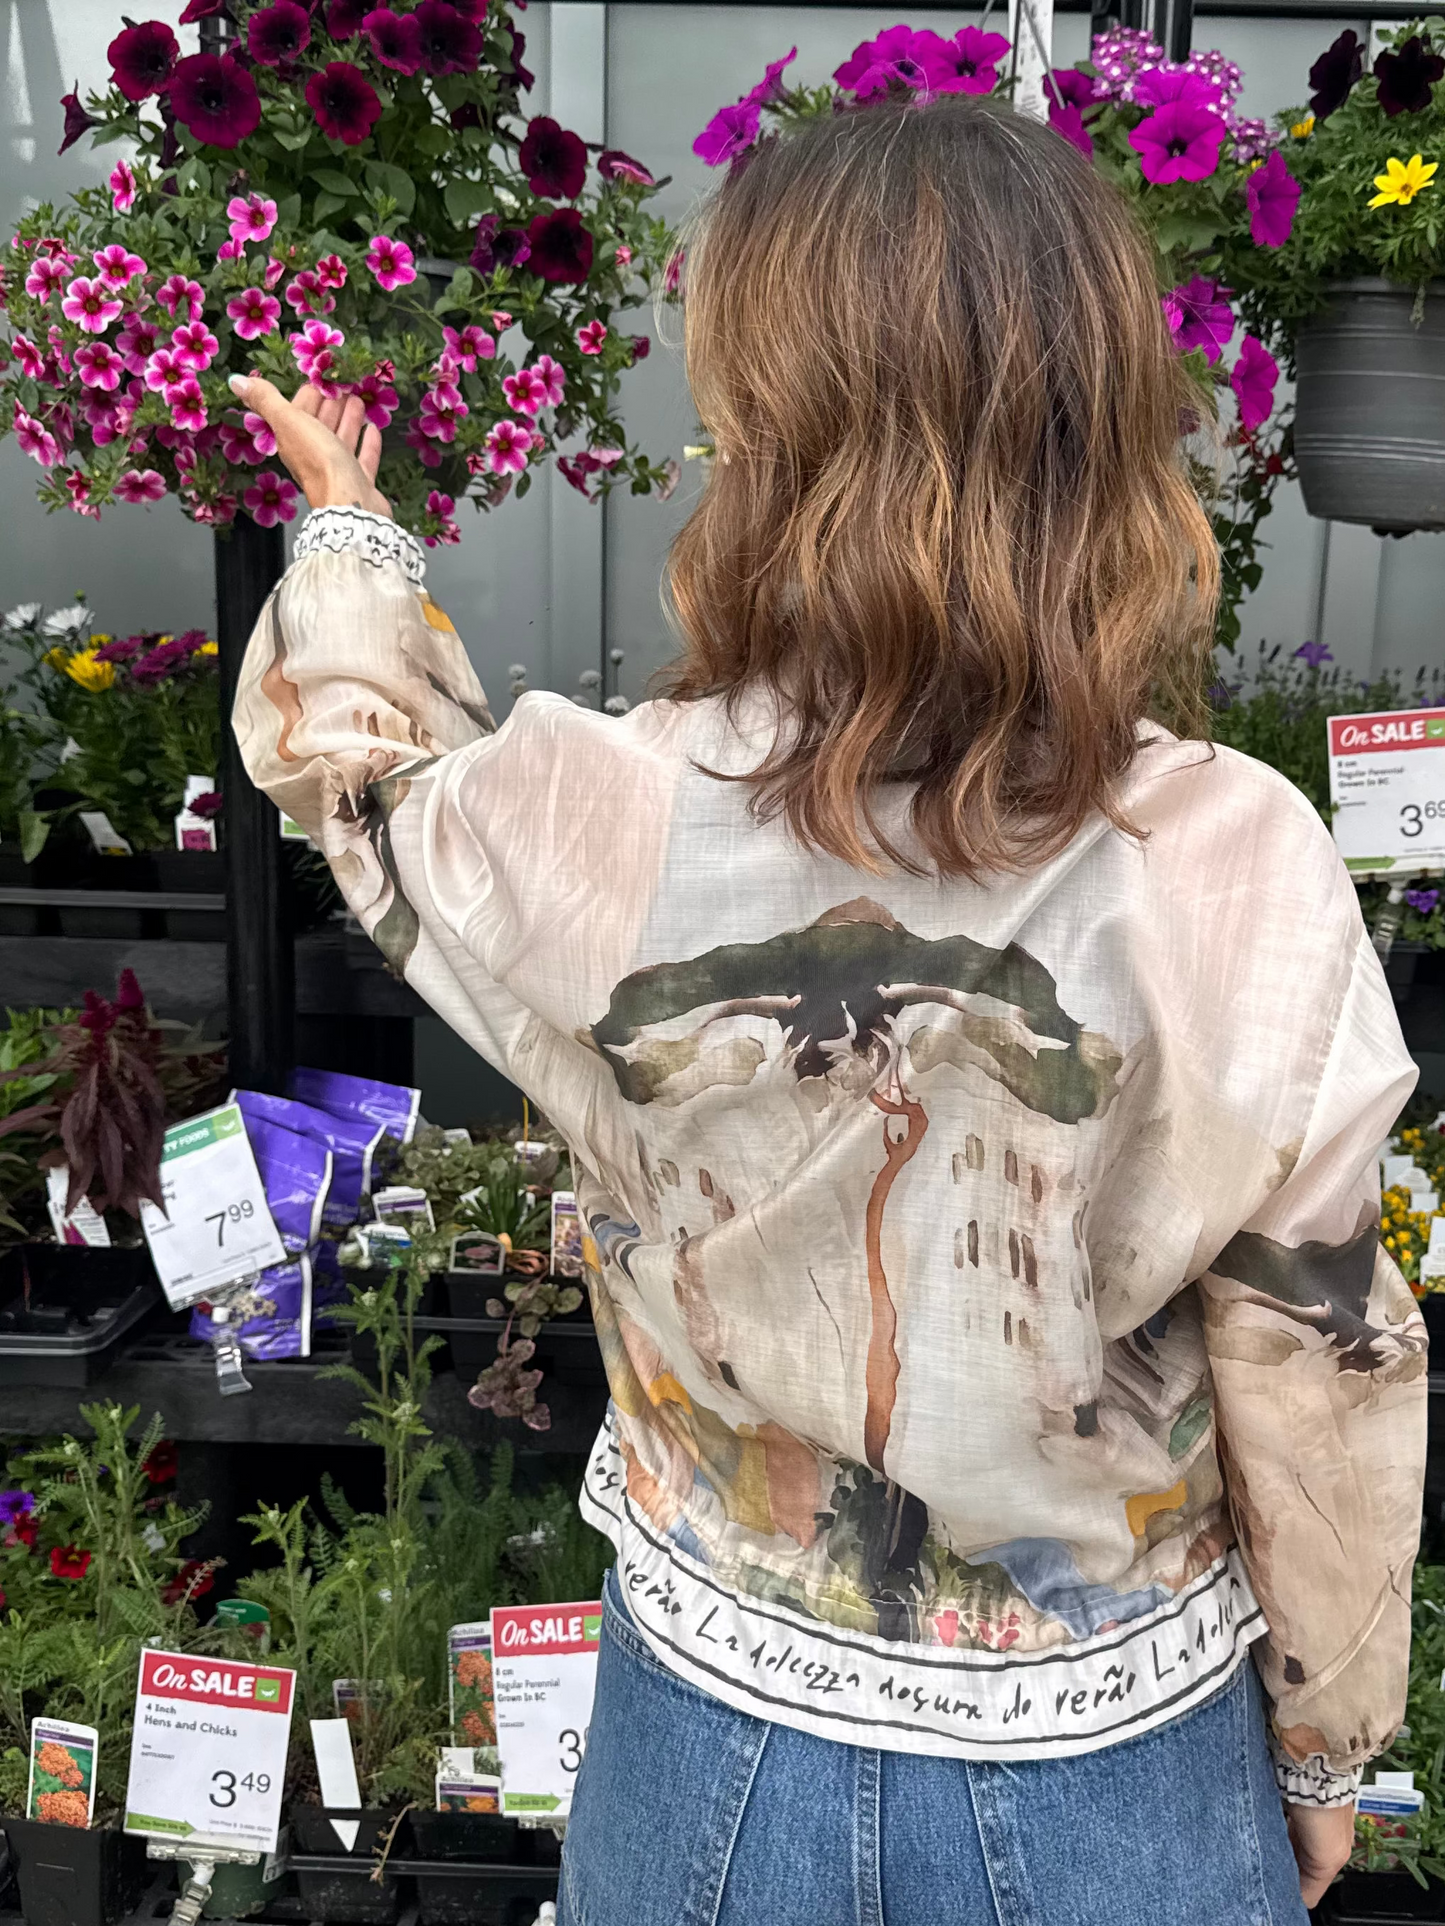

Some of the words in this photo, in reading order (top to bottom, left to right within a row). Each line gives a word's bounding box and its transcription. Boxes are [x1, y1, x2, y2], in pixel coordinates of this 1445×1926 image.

[1340, 725, 1370, 747] On
[1370, 720, 1425, 744] SALE
[179, 1128, 210, 1147] FOODS
[501, 1619, 529, 1647] On
[529, 1616, 583, 1644] SALE
[152, 1664, 188, 1691] On
[188, 1668, 255, 1698] SALE
[525, 1678, 560, 1689] Perennial
[146, 1703, 152, 1711] 4
[154, 1703, 177, 1715] Inch
[497, 1694, 523, 1703] Grown
[144, 1714, 172, 1728] Hens
[175, 1720, 197, 1732] and
[200, 1722, 238, 1738] Chicks
